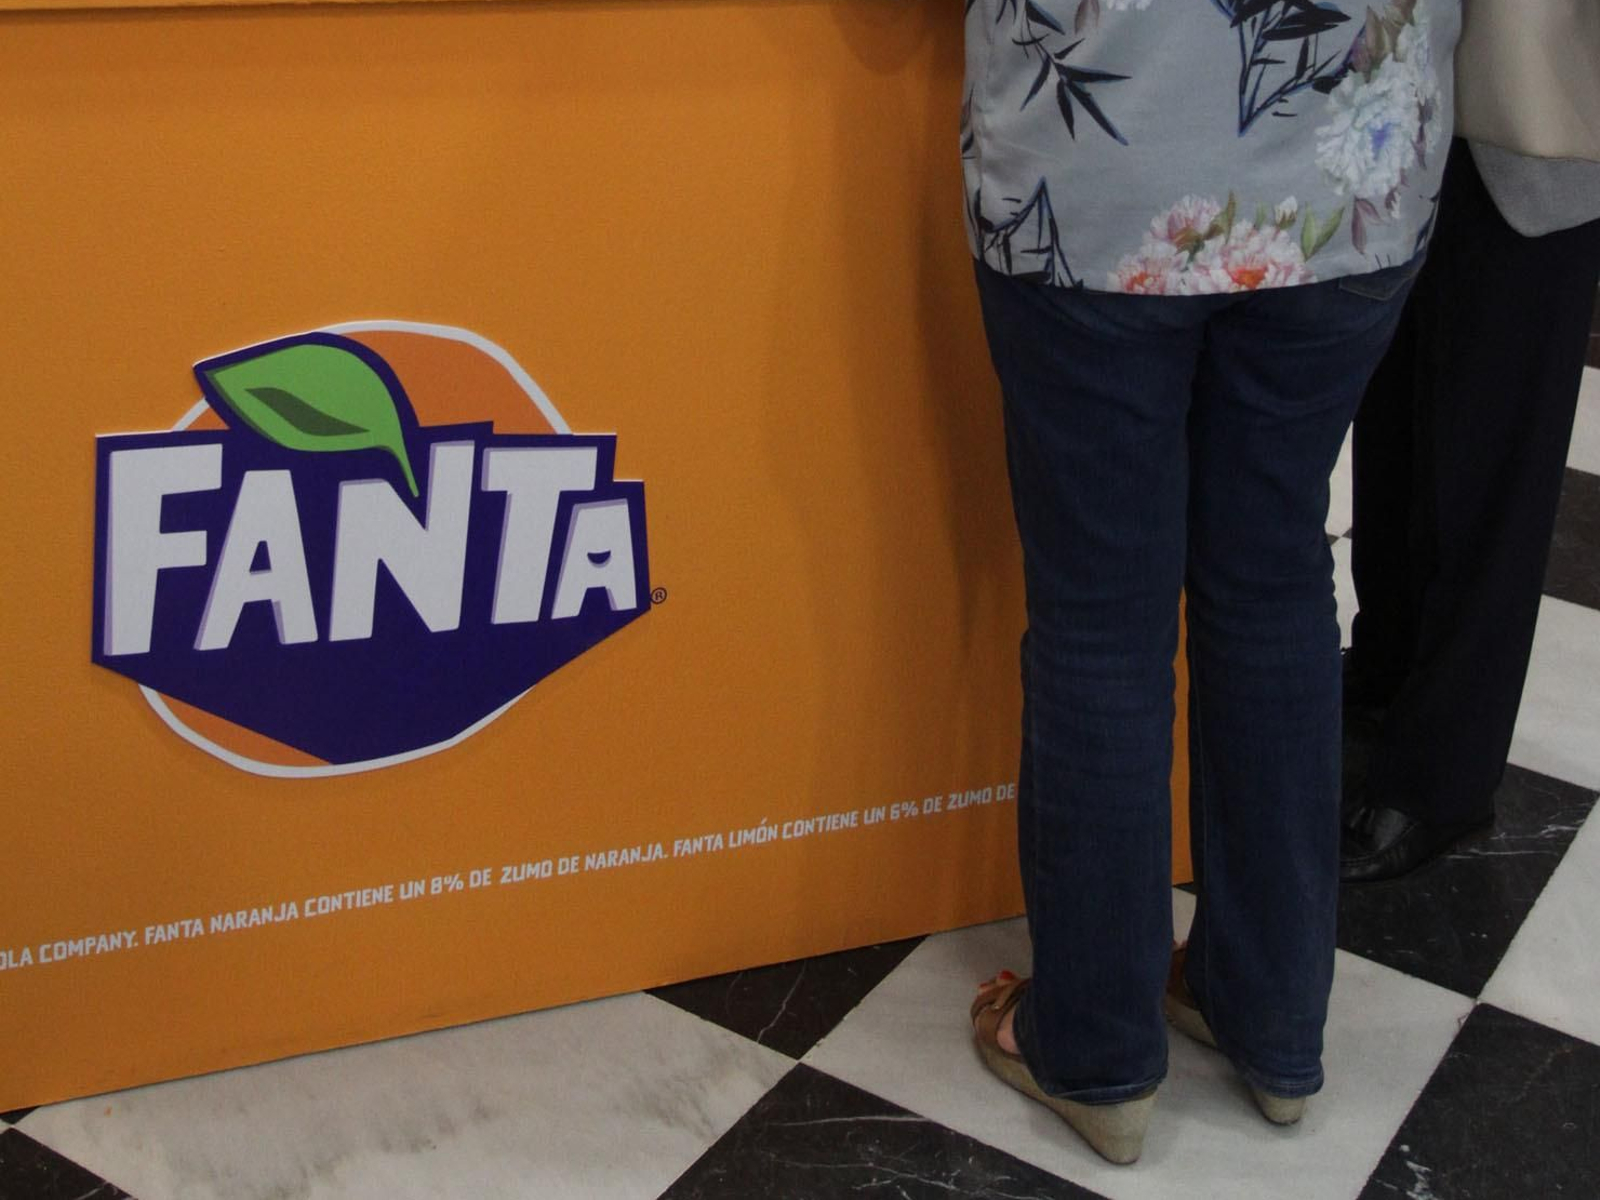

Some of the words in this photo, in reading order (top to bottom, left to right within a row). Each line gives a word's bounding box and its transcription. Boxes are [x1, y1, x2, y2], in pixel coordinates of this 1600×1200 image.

[102, 439, 638, 657] FANTA
[39, 929, 139, 963] COMPANY.
[145, 918, 204, 945] FANTA
[210, 902, 299, 933] NARANJA
[304, 884, 394, 918] CONTIENE
[400, 878, 426, 900] UN
[430, 873, 464, 895] 8%
[469, 868, 492, 888] DE
[500, 859, 553, 884] ZUMO
[557, 855, 580, 875] DE
[584, 842, 668, 870] NARANJA.
[673, 833, 724, 858] FANTA
[728, 817, 778, 848] LIMÓN
[782, 811, 858, 839] CONTIENE
[863, 805, 886, 826] UN
[890, 800, 919, 821] 6%
[923, 794, 943, 815] DE
[947, 786, 992, 811] ZUMO
[996, 782, 1016, 802] DE
